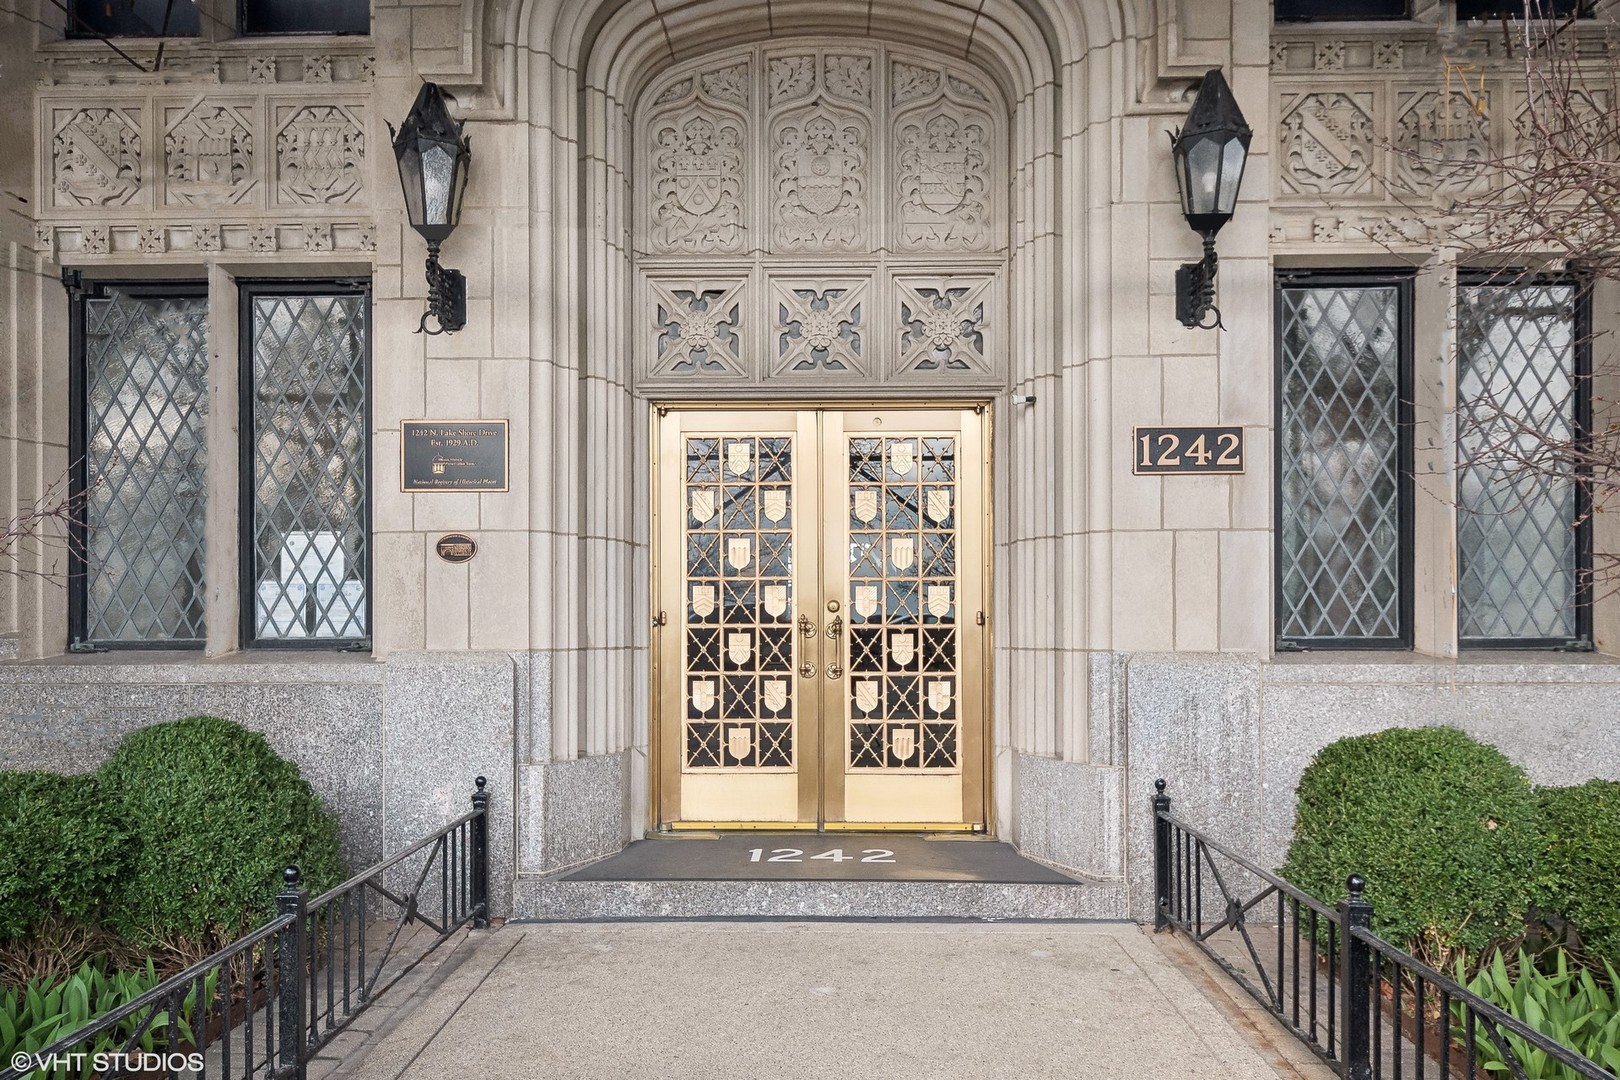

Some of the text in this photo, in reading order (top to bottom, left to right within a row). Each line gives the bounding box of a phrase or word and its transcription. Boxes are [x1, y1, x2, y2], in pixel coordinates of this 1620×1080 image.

[446, 439, 461, 447] 1929
[1140, 434, 1240, 466] 1242
[749, 848, 896, 862] 1242
